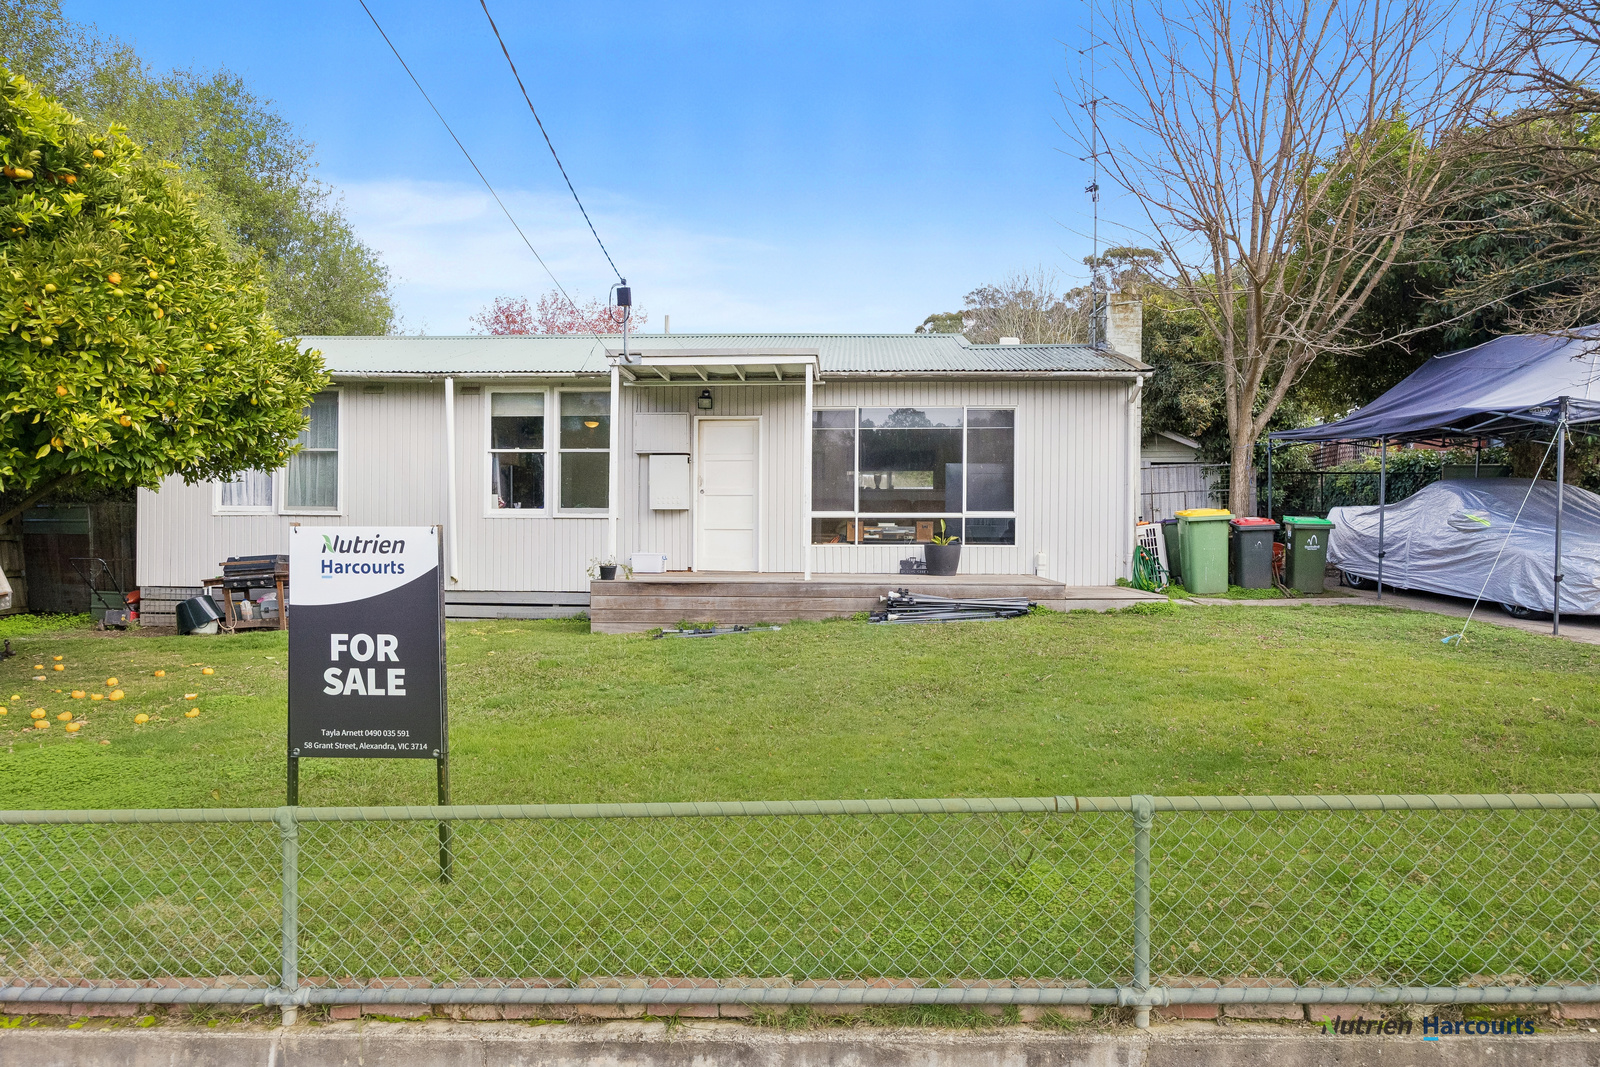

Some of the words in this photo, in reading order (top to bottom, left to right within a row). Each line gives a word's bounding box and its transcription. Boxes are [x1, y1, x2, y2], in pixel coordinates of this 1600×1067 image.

[322, 533, 406, 554] Nutrien
[321, 559, 405, 575] Harcourts
[330, 633, 400, 662] FOR
[323, 667, 407, 697] SALE
[321, 728, 341, 738] Tayla
[341, 729, 364, 737] Arnett
[364, 729, 382, 737] 0490
[382, 729, 396, 737] 035
[396, 729, 410, 737] 591
[303, 741, 313, 749] 58
[313, 741, 334, 749] Grant
[334, 741, 358, 750] Street,
[359, 742, 397, 751] Alexandra,
